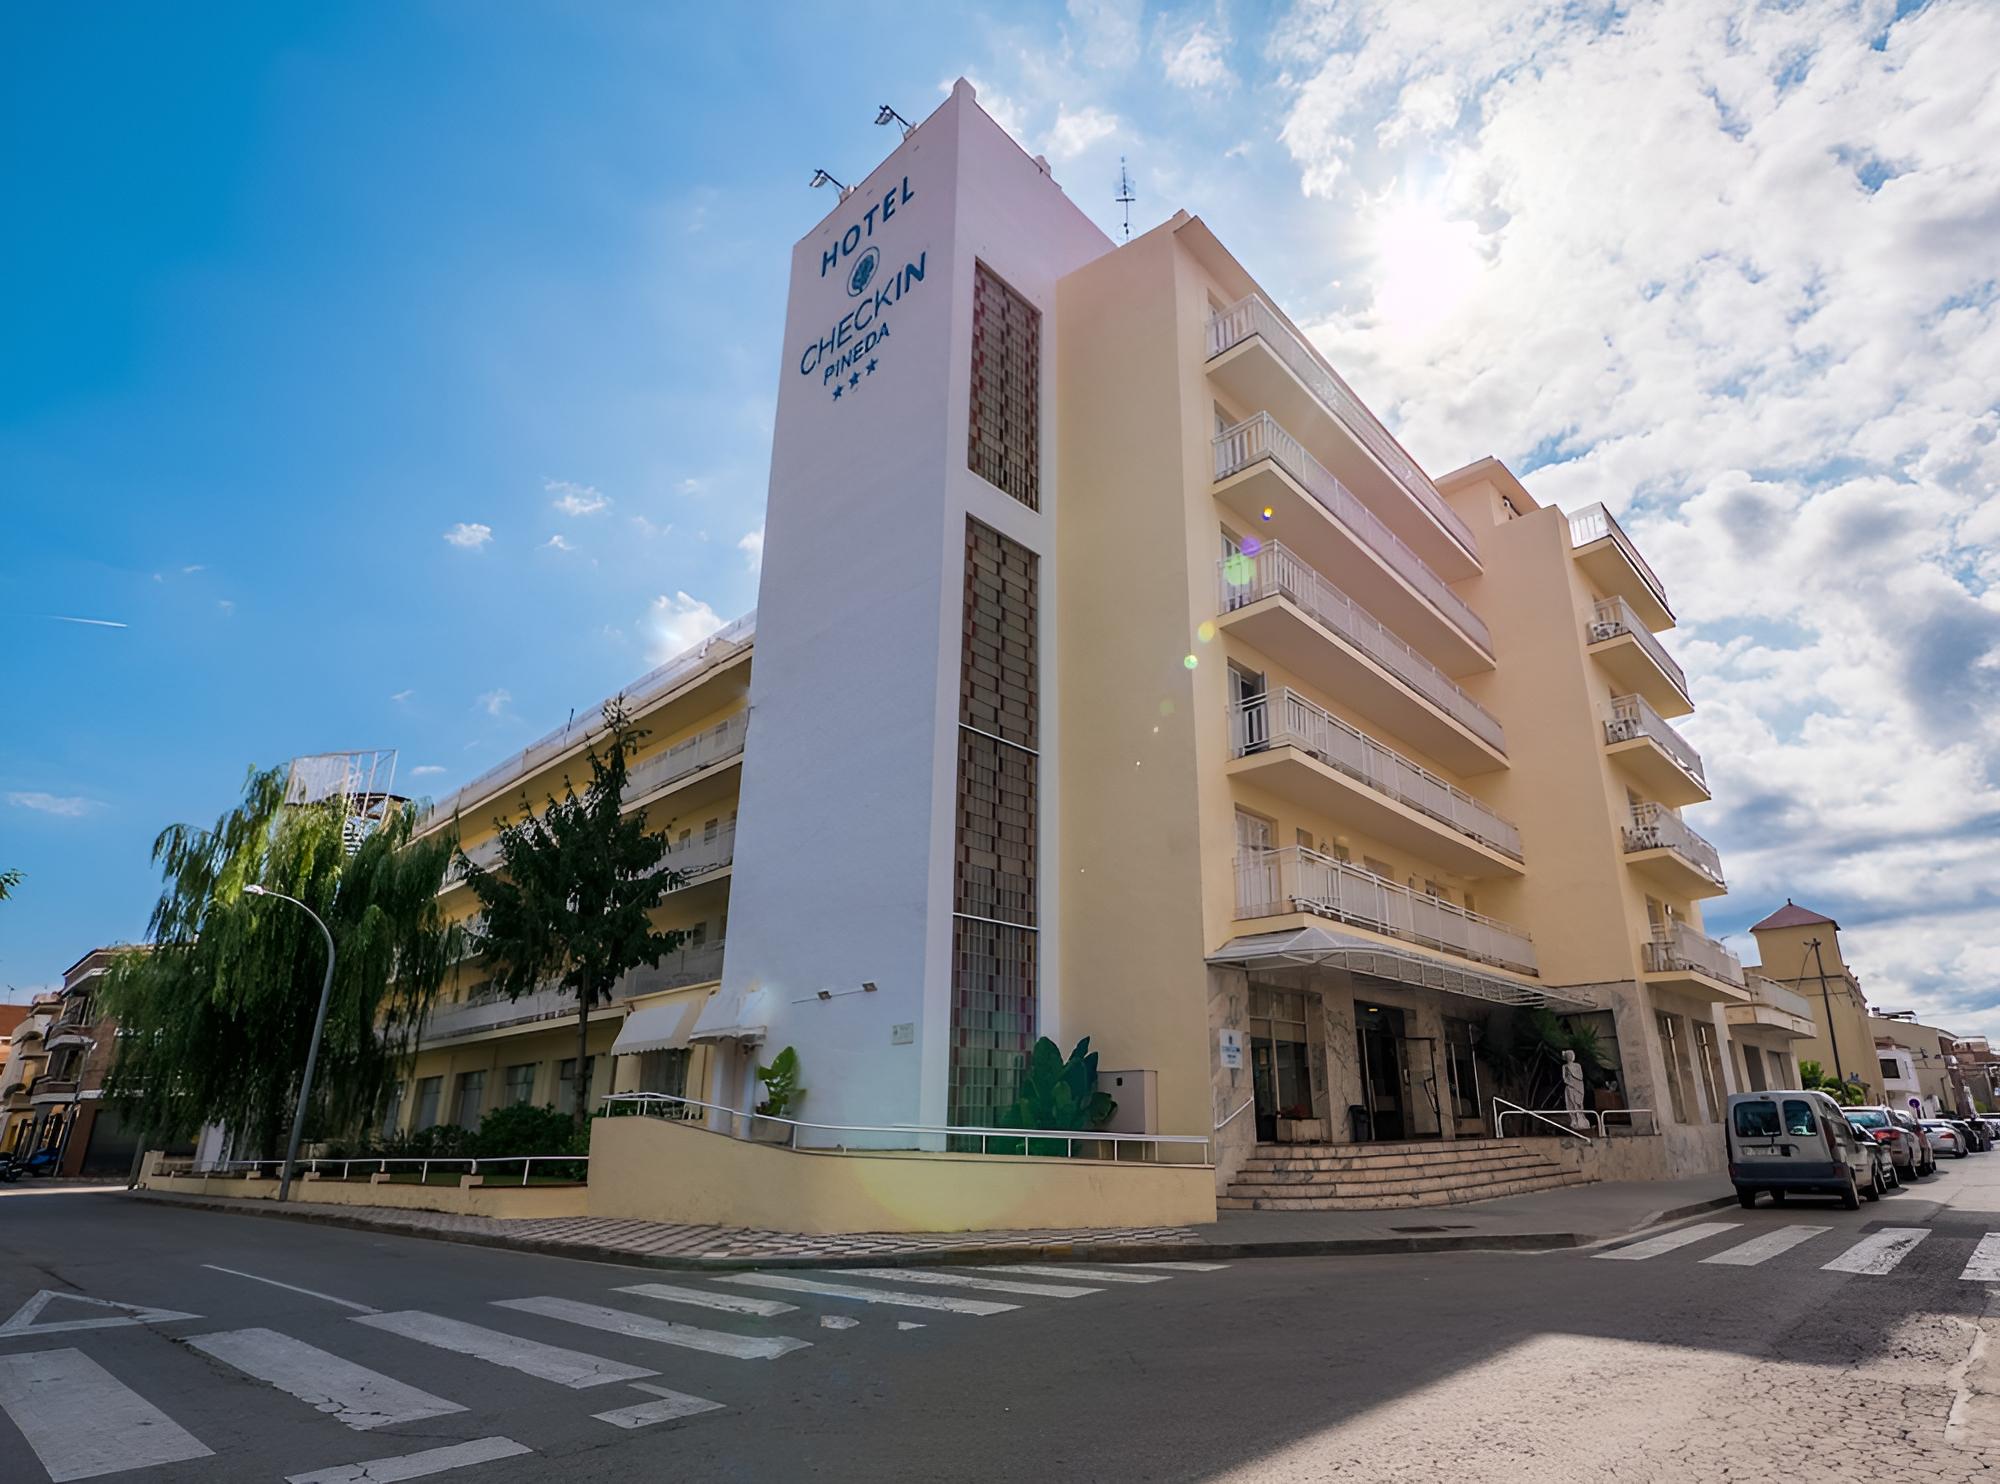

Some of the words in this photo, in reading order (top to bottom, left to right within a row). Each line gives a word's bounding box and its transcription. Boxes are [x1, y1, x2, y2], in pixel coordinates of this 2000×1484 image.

[821, 176, 915, 277] HOTEL
[800, 252, 926, 375] CHECKIN
[823, 322, 890, 386] PINEDA
